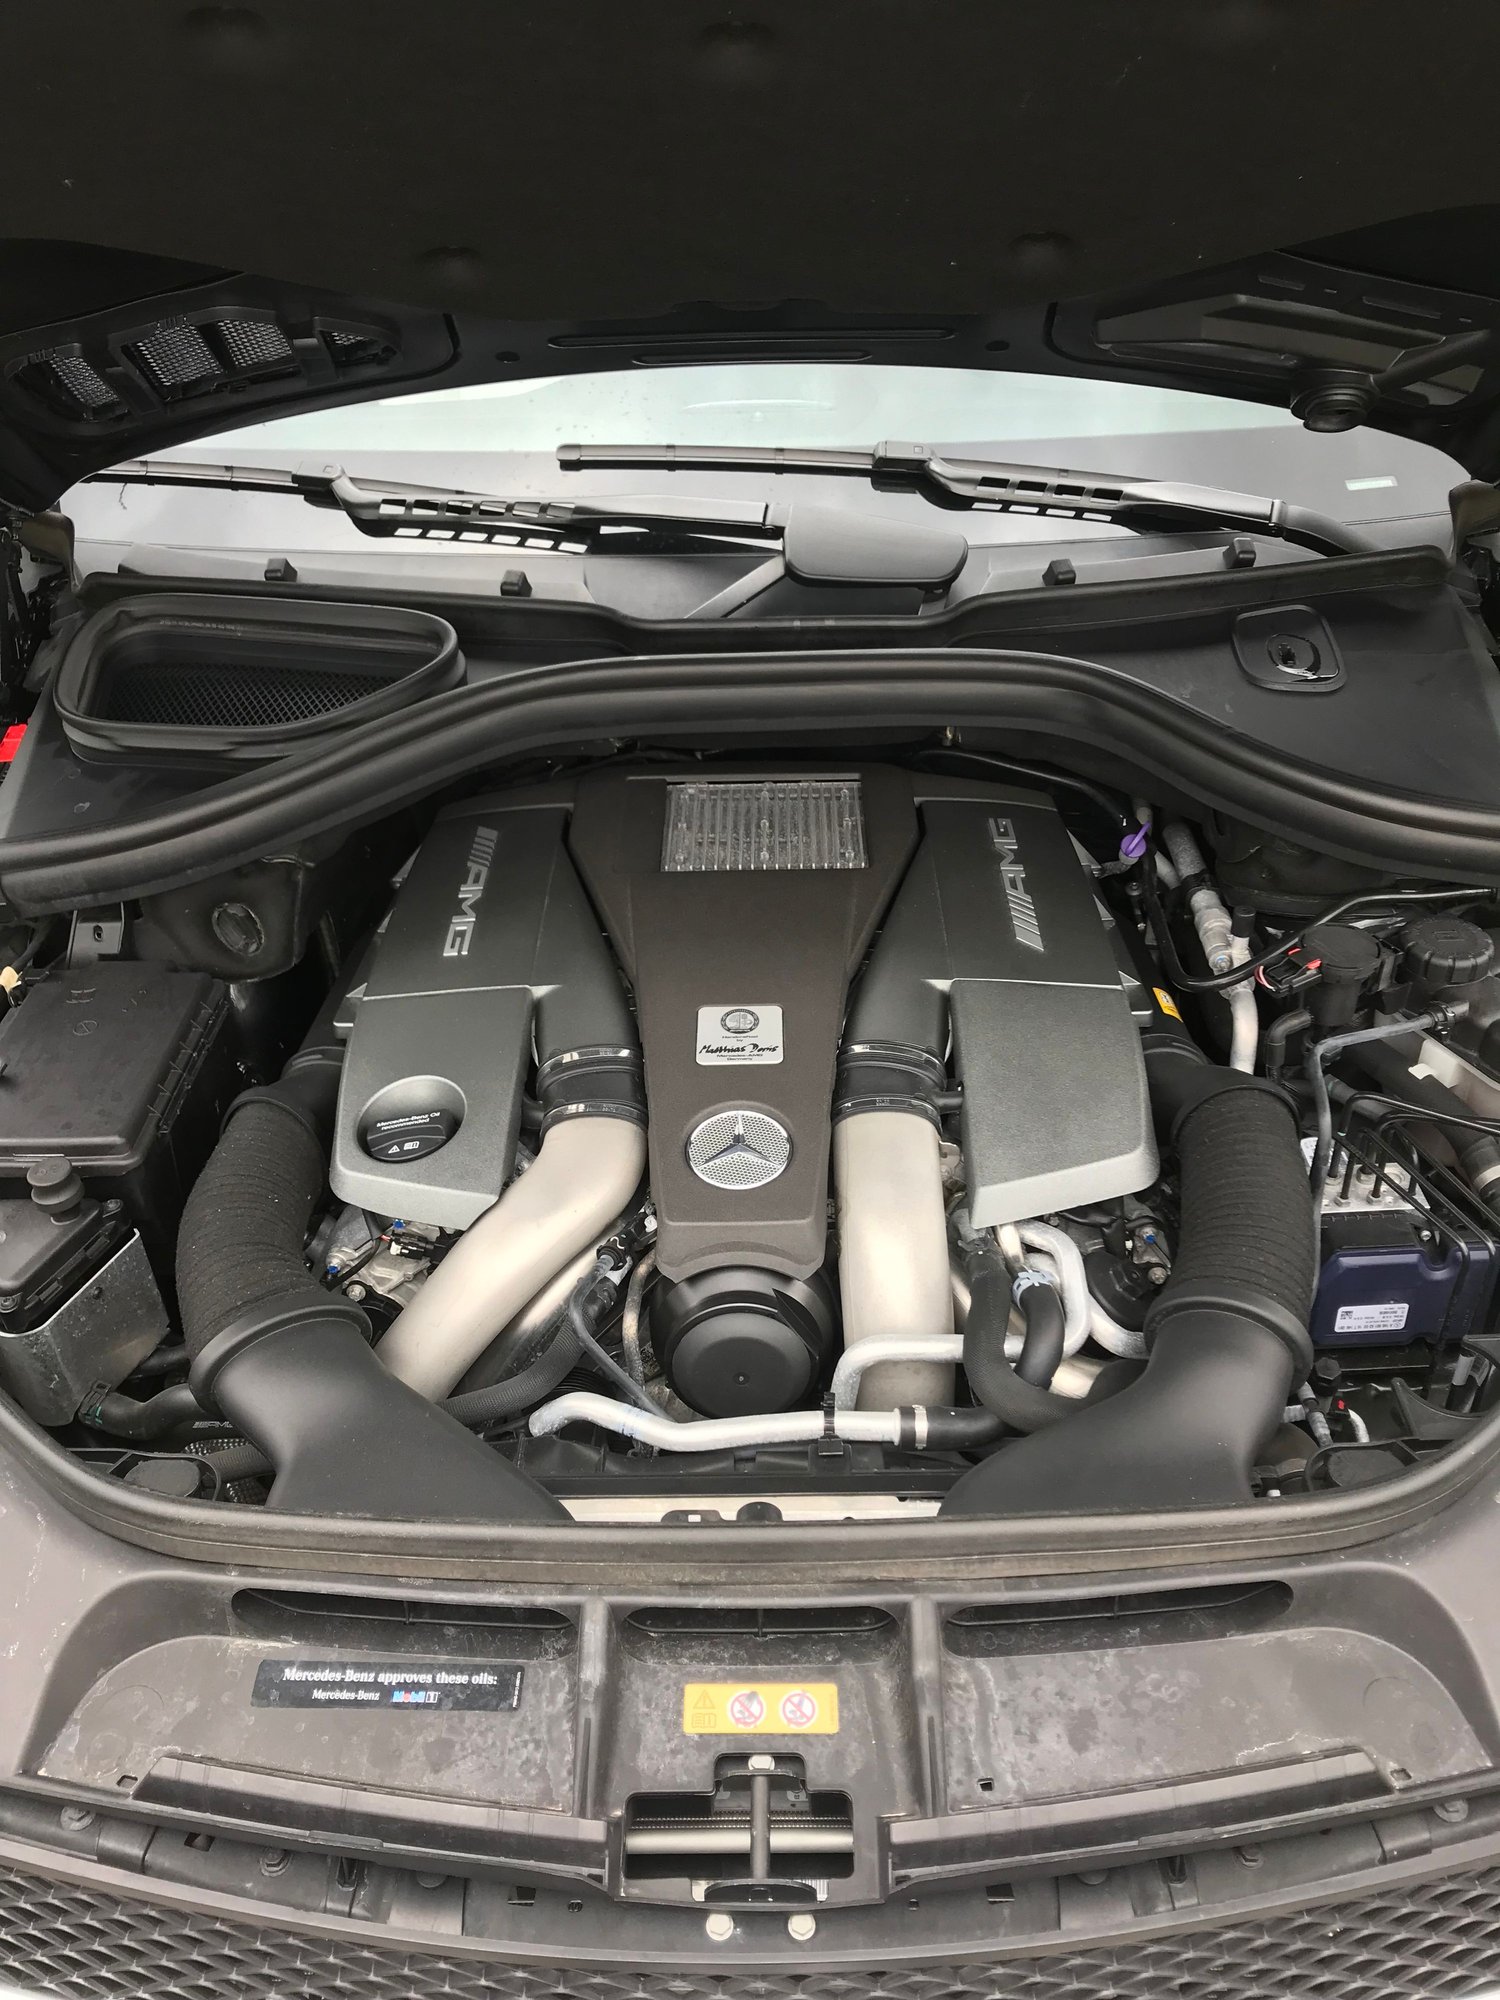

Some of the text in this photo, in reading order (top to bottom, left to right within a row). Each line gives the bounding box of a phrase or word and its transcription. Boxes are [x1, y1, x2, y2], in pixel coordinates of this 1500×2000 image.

[988, 817, 1033, 904] AMG
[443, 860, 489, 957] AMG
[376, 1114, 429, 1127] Mercedes-Benz
[381, 1118, 430, 1130] recommended
[282, 1667, 498, 1686] Mercedes-Benz approves these oils:
[311, 1688, 380, 1701] Mercedes-Benz
[392, 1690, 426, 1703] Mobil
